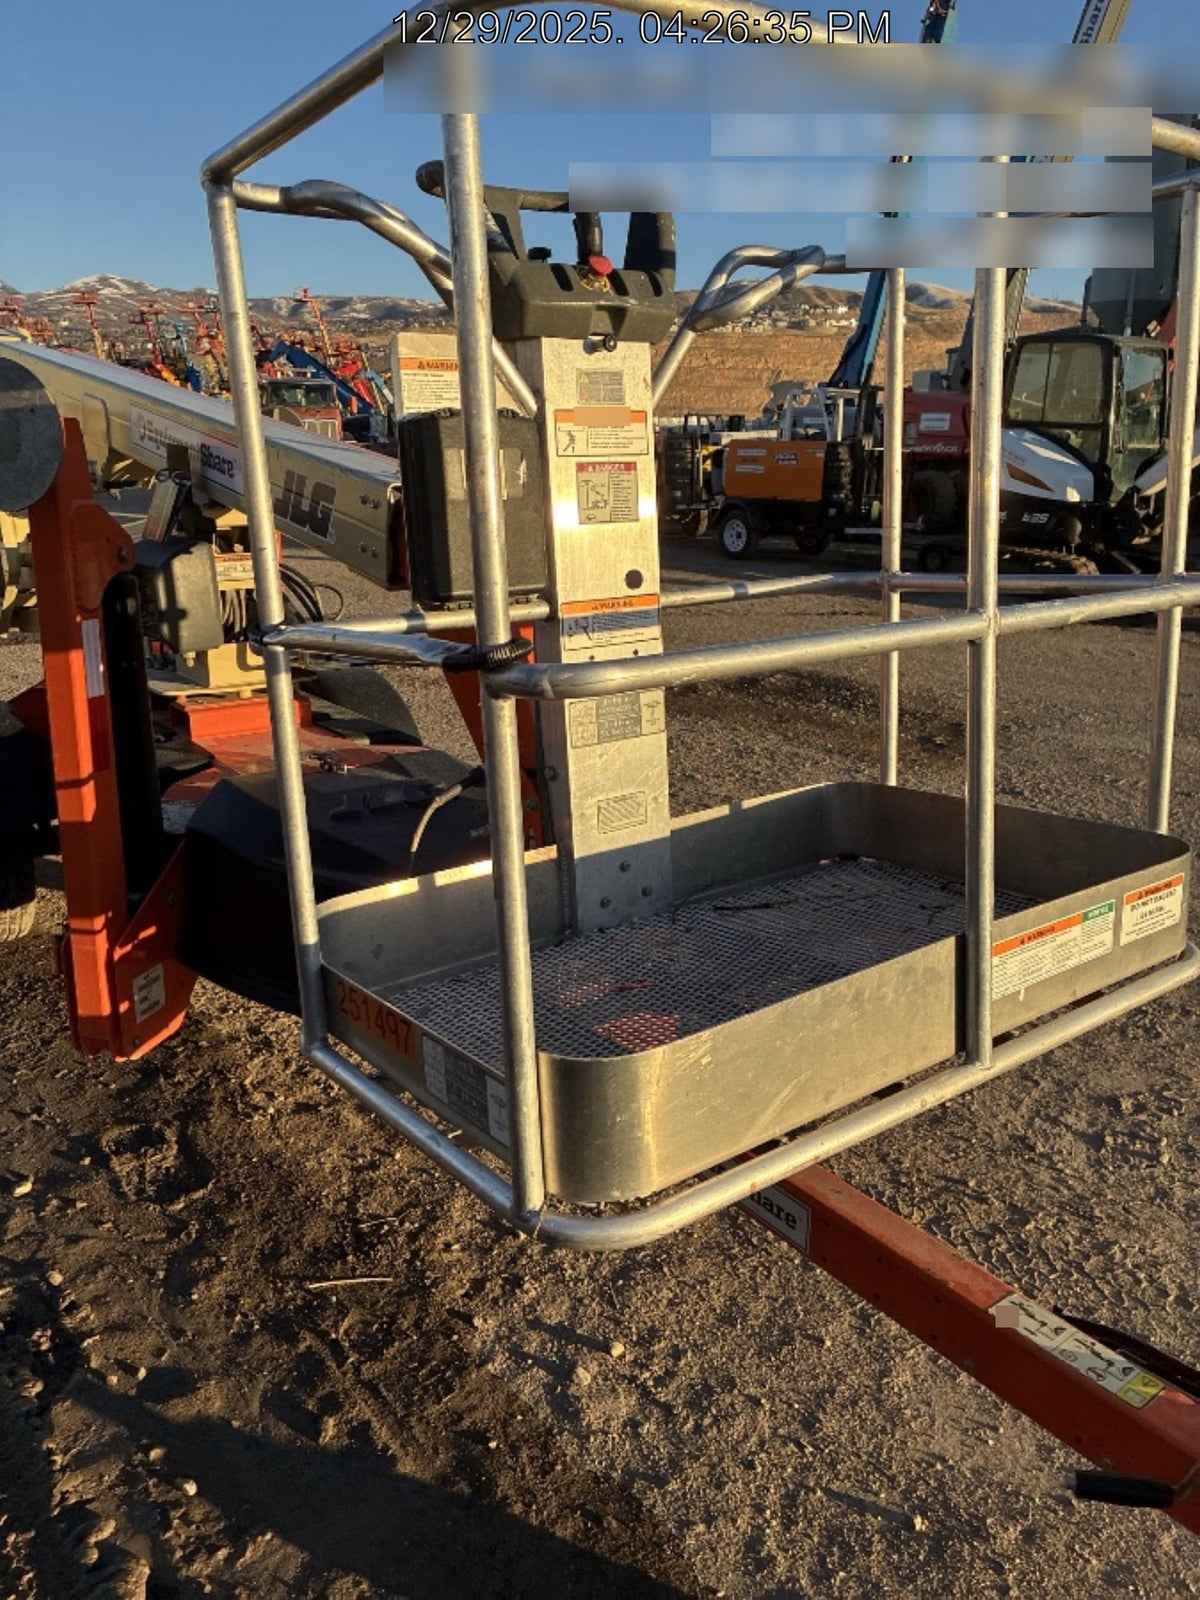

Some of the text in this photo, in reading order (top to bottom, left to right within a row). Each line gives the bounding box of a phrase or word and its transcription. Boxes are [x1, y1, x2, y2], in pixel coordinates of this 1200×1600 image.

[1079, 0, 1104, 43] har
[273, 469, 337, 540] JLG
[337, 979, 413, 1056] 251497
